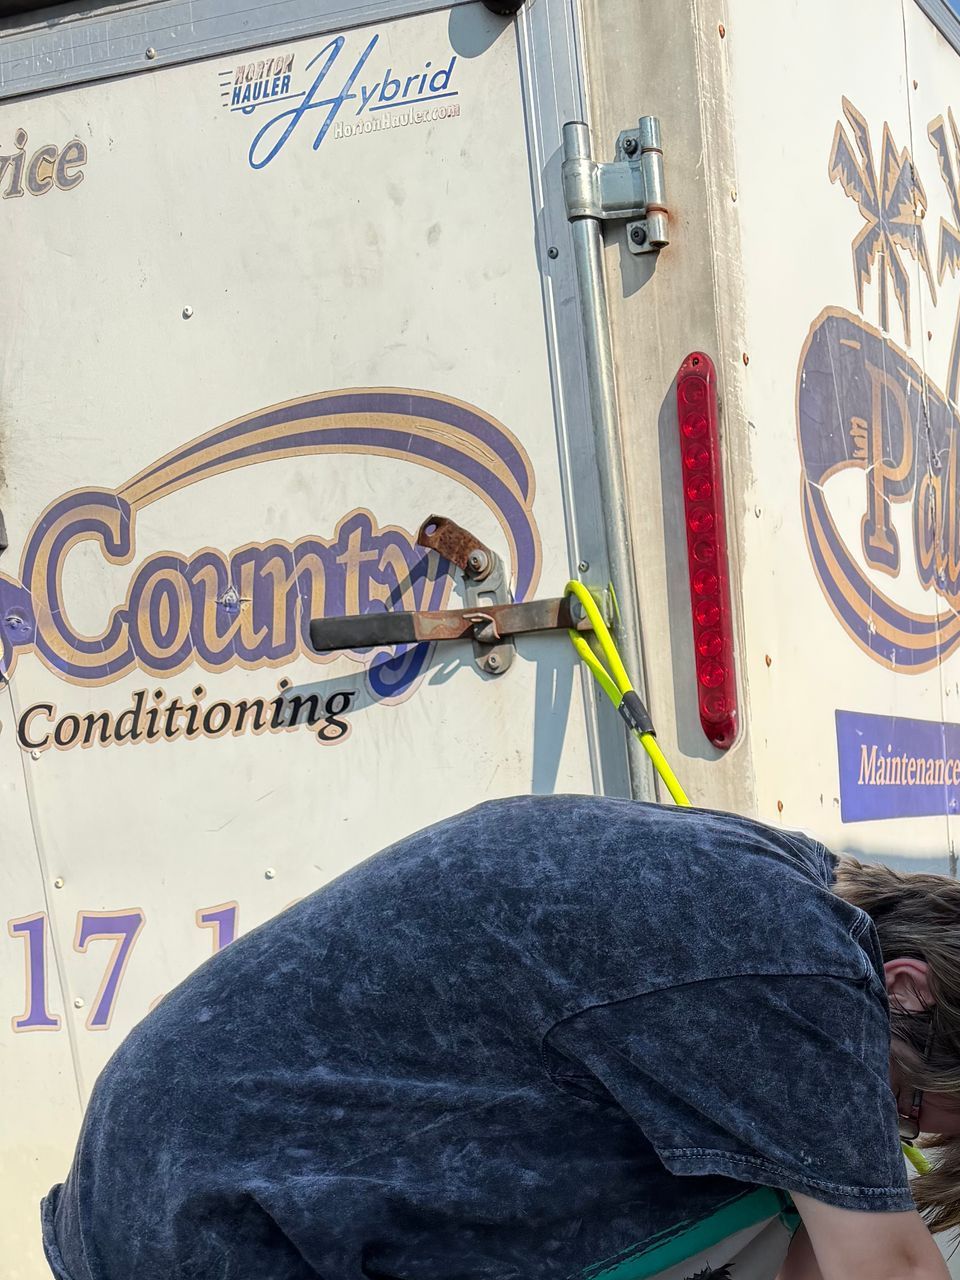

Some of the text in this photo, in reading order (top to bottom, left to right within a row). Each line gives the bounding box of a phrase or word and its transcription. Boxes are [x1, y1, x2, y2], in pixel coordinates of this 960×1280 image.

[231, 73, 292, 106] HAULER
[234, 53, 296, 86] HORTON
[249, 34, 458, 170] Hybrid
[333, 103, 461, 140] HortonHauler.com
[20, 487, 454, 706] County
[17, 677, 357, 743] Conditioning
[857, 743, 960, 787] Maintenance
